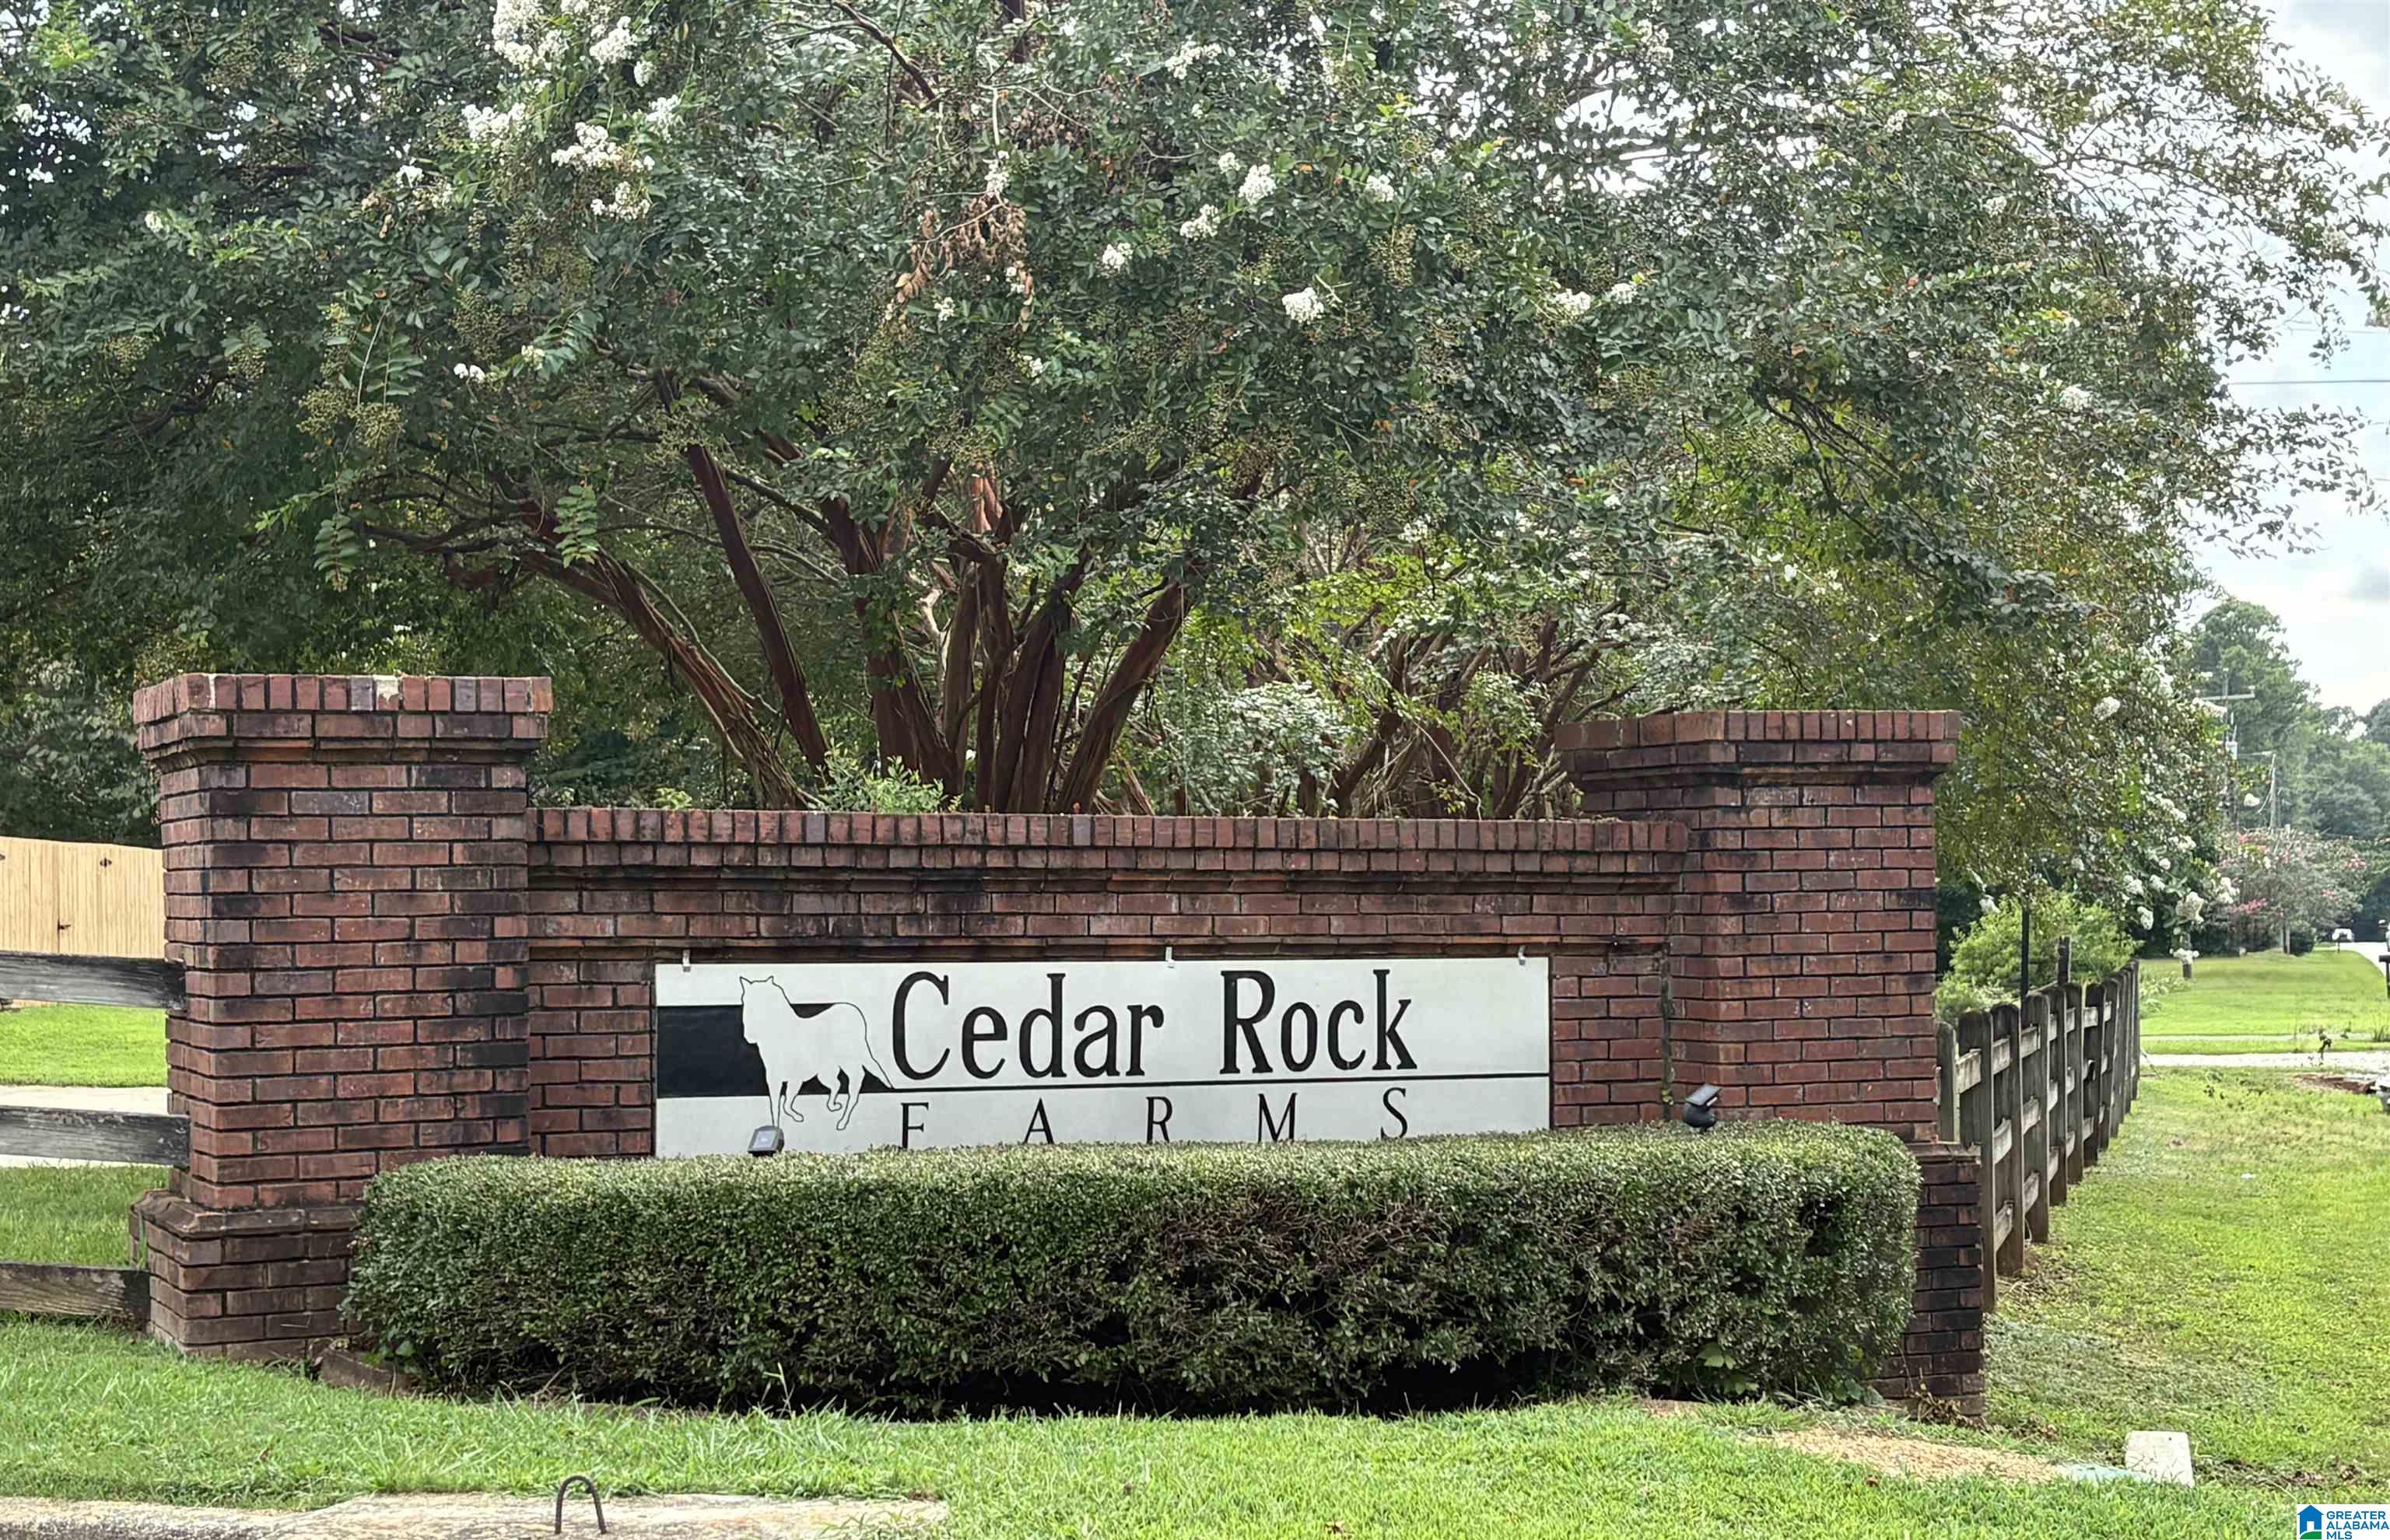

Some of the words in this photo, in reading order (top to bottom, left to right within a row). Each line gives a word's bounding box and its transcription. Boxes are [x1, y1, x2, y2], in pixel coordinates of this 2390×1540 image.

[892, 971, 1164, 1080] Cedar
[1219, 969, 1418, 1074] Rock
[900, 1087, 1408, 1150] FARMS
